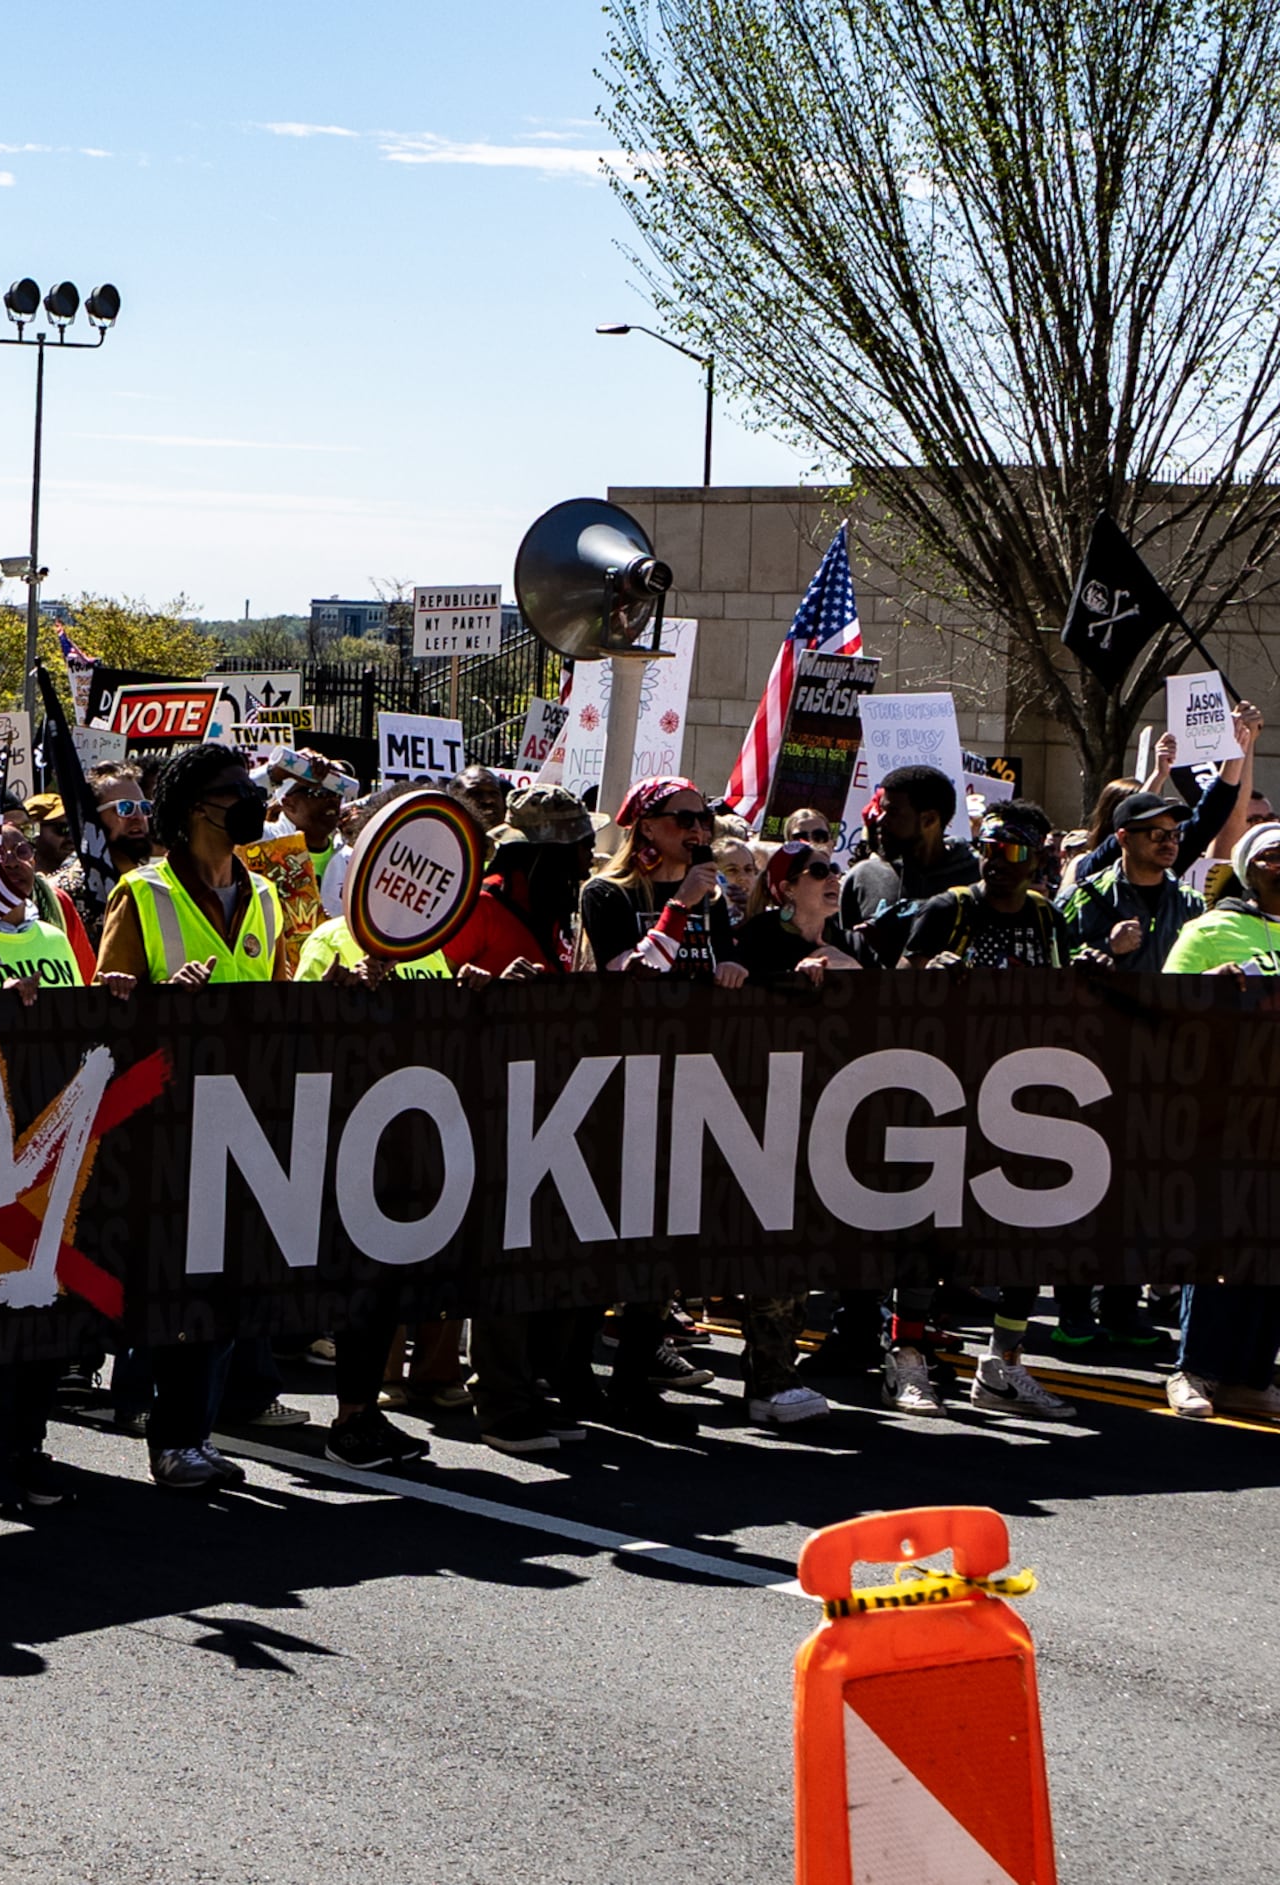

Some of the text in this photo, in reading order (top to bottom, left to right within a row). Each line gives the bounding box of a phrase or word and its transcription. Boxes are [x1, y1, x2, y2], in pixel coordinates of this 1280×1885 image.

[420, 593, 497, 608] REPUBLICAN
[425, 616, 491, 631] MY PARTY
[425, 635, 458, 650] LEFT
[800, 653, 846, 679] WARNING
[826, 680, 839, 691] OF
[866, 703, 903, 719] THIS
[1187, 692, 1223, 712] JASON
[121, 702, 207, 734] VOTE
[258, 710, 311, 725] HANDS
[1186, 709, 1225, 726] ESTEVES
[871, 730, 892, 746] OF
[896, 728, 945, 751] BLUEY
[1185, 724, 1225, 738] GOVERNOR
[386, 733, 461, 774] MELT
[571, 749, 676, 776] NEE YOUR
[991, 757, 1016, 782] NO
[388, 840, 456, 893] UNITE
[374, 867, 439, 919] HERE!
[679, 947, 708, 959] ORE
[186, 1047, 1113, 1274] NO KINGS
